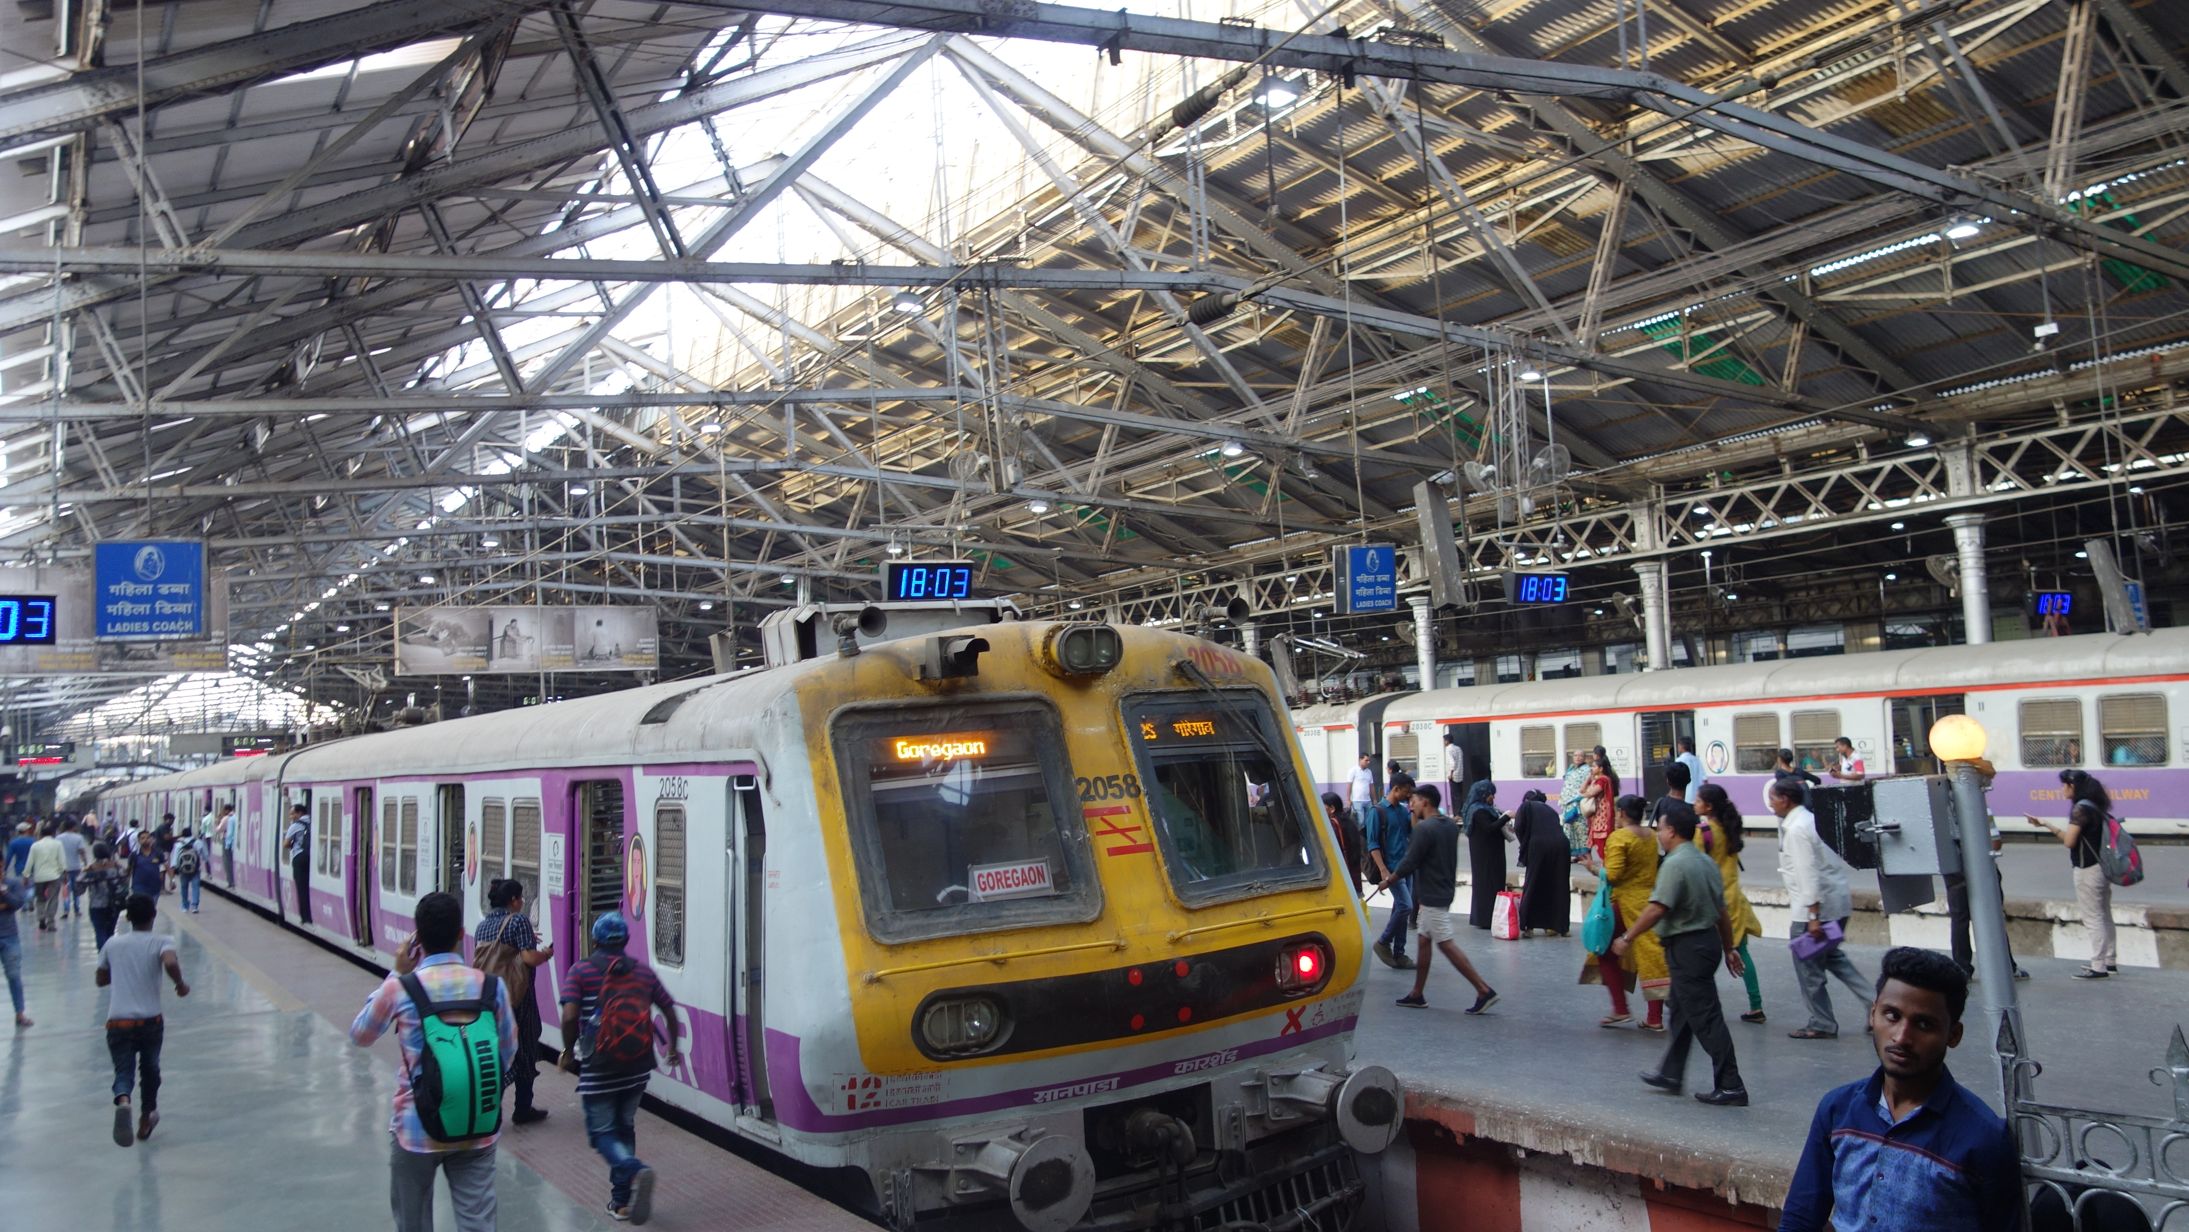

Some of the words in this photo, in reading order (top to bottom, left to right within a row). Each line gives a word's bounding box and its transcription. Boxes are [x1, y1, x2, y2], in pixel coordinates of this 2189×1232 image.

[109, 581, 152, 596] महिला
[900, 568, 969, 597] 18:03
[1521, 576, 1566, 601] 18:03
[106, 600, 150, 616] महिला
[1355, 600, 1374, 608] LADIES
[1374, 599, 1392, 607] COACH
[107, 622, 149, 633] LADIES
[152, 620, 193, 632] COACH
[896, 741, 985, 760] Goregaon
[659, 776, 689, 800] 2058C
[1075, 774, 1141, 801] 2058
[977, 865, 1046, 892] GOREGAON
[847, 1077, 882, 1111] 12
[1033, 1077, 1120, 1103] सानपाडा
